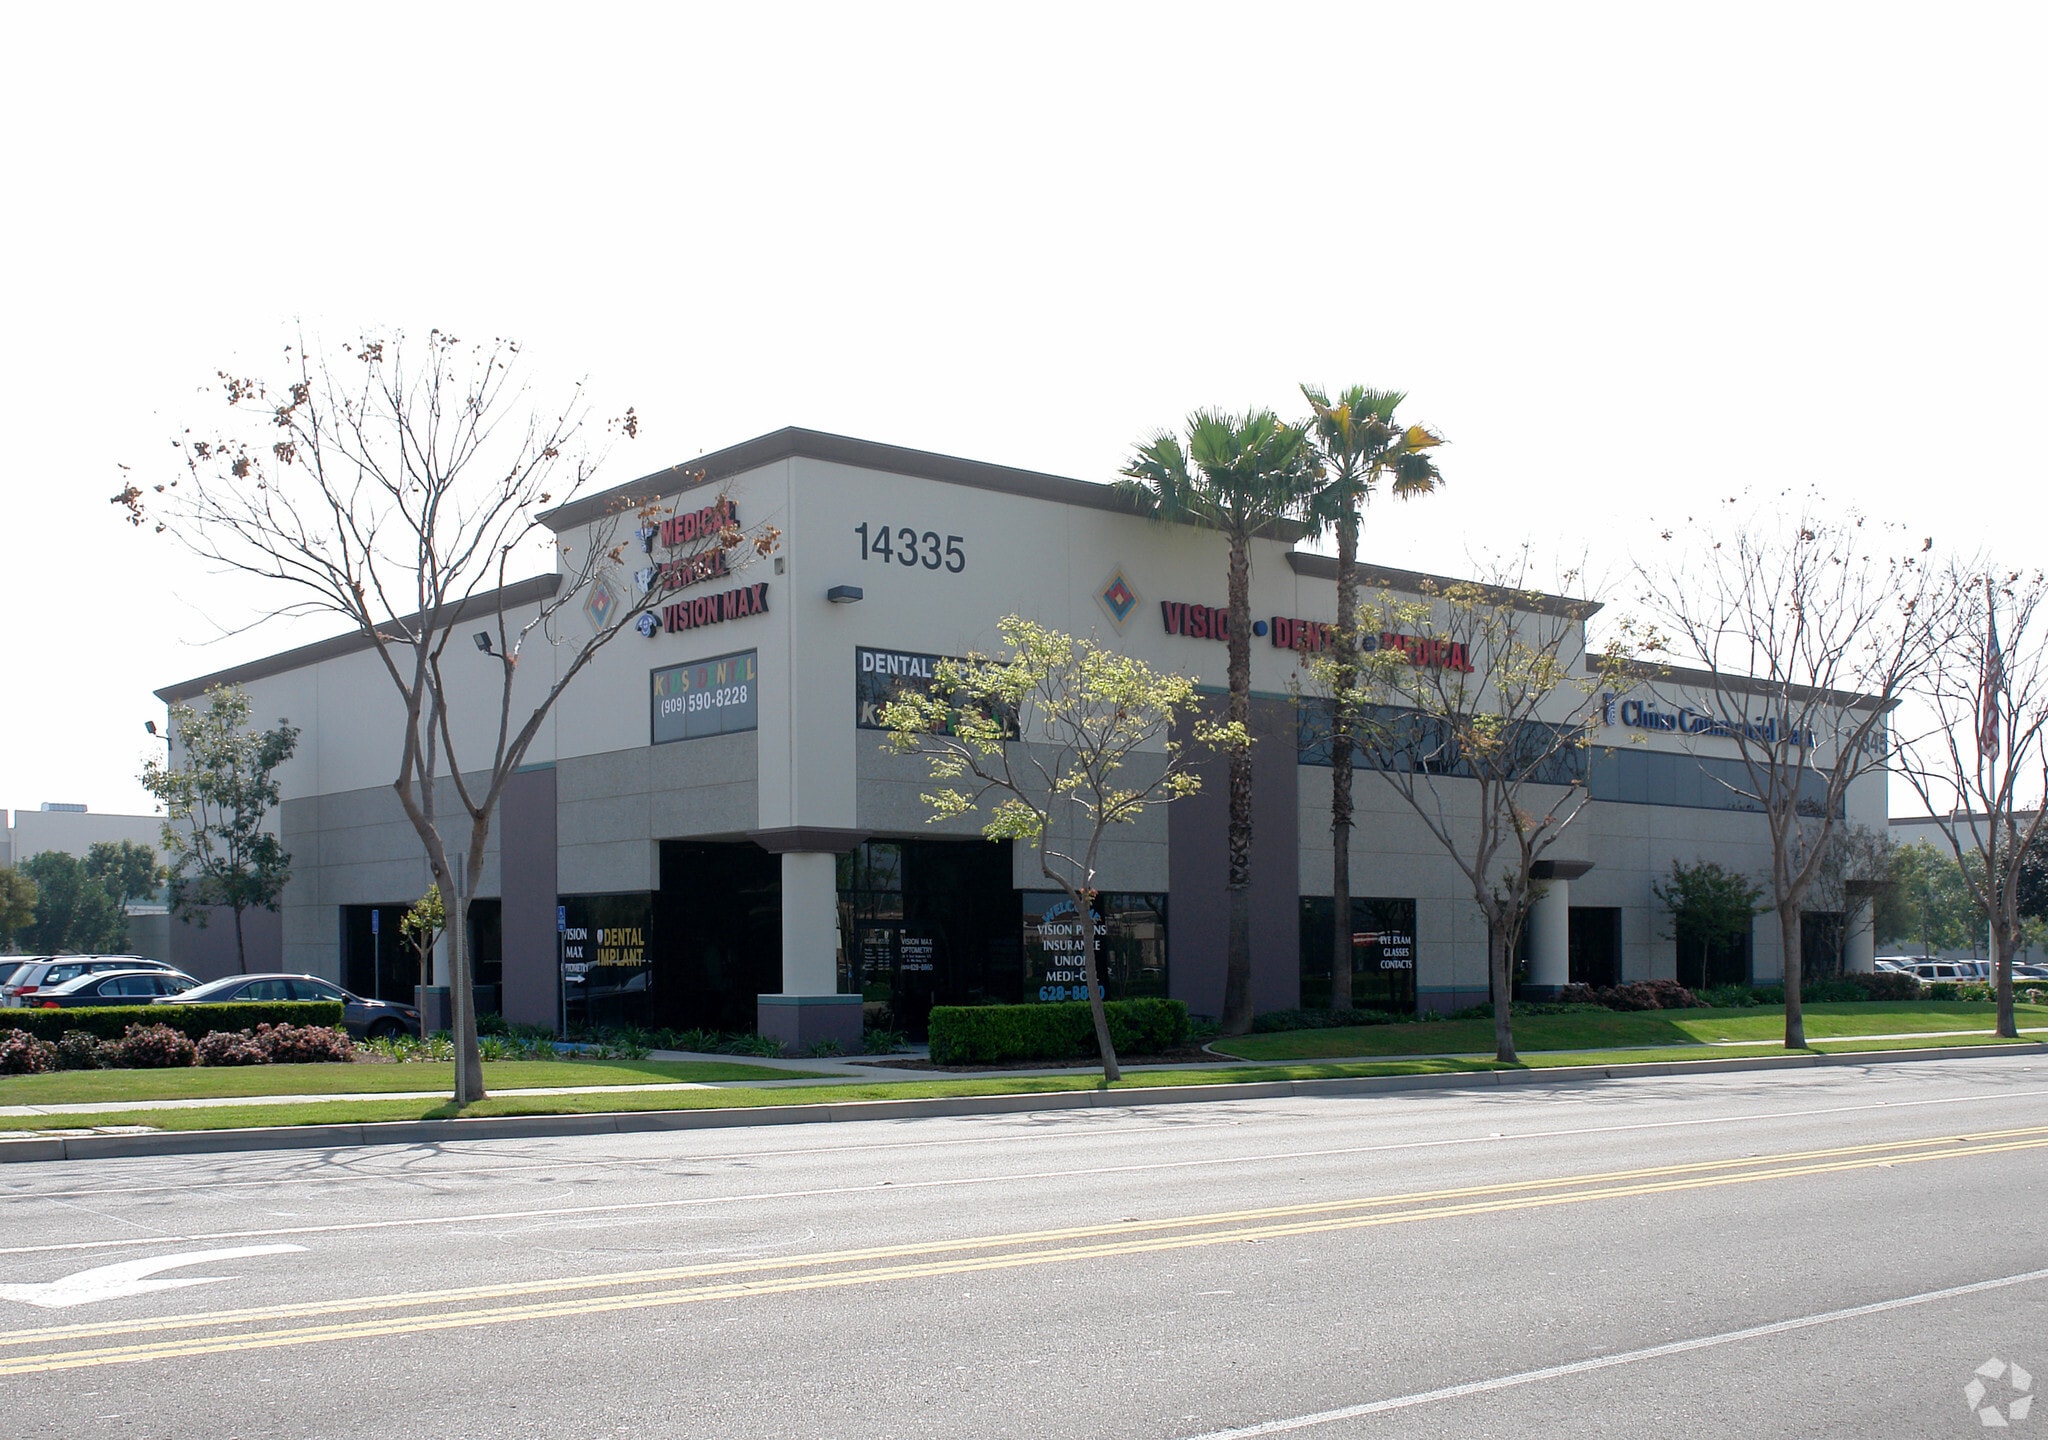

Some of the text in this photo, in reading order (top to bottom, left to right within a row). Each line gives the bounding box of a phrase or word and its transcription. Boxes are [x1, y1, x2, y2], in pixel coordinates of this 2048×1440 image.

[661, 500, 739, 548] MEDICAL
[854, 522, 966, 573] 14335
[662, 583, 768, 633] VISION MAX
[1161, 601, 1244, 641] VISIO
[862, 652, 932, 678] DENTAL
[655, 658, 755, 697] KIDS DENTAL
[661, 684, 748, 718] (909) 590-8228
[1621, 700, 1677, 730] Chino
[603, 928, 645, 946] DENTAL
[1037, 924, 1107, 936] VISION PNS
[1043, 940, 1101, 951] INSURAE
[1380, 936, 1411, 945] EYE EXAM
[565, 946, 584, 958] MAX
[597, 948, 644, 967] IMPLANT
[1054, 955, 1087, 967] UNIO
[1383, 948, 1410, 957] GLASSES
[1380, 960, 1413, 969] CONTACTS
[1046, 971, 1100, 982] MEDI-C
[1039, 986, 1106, 1001] 628-880
